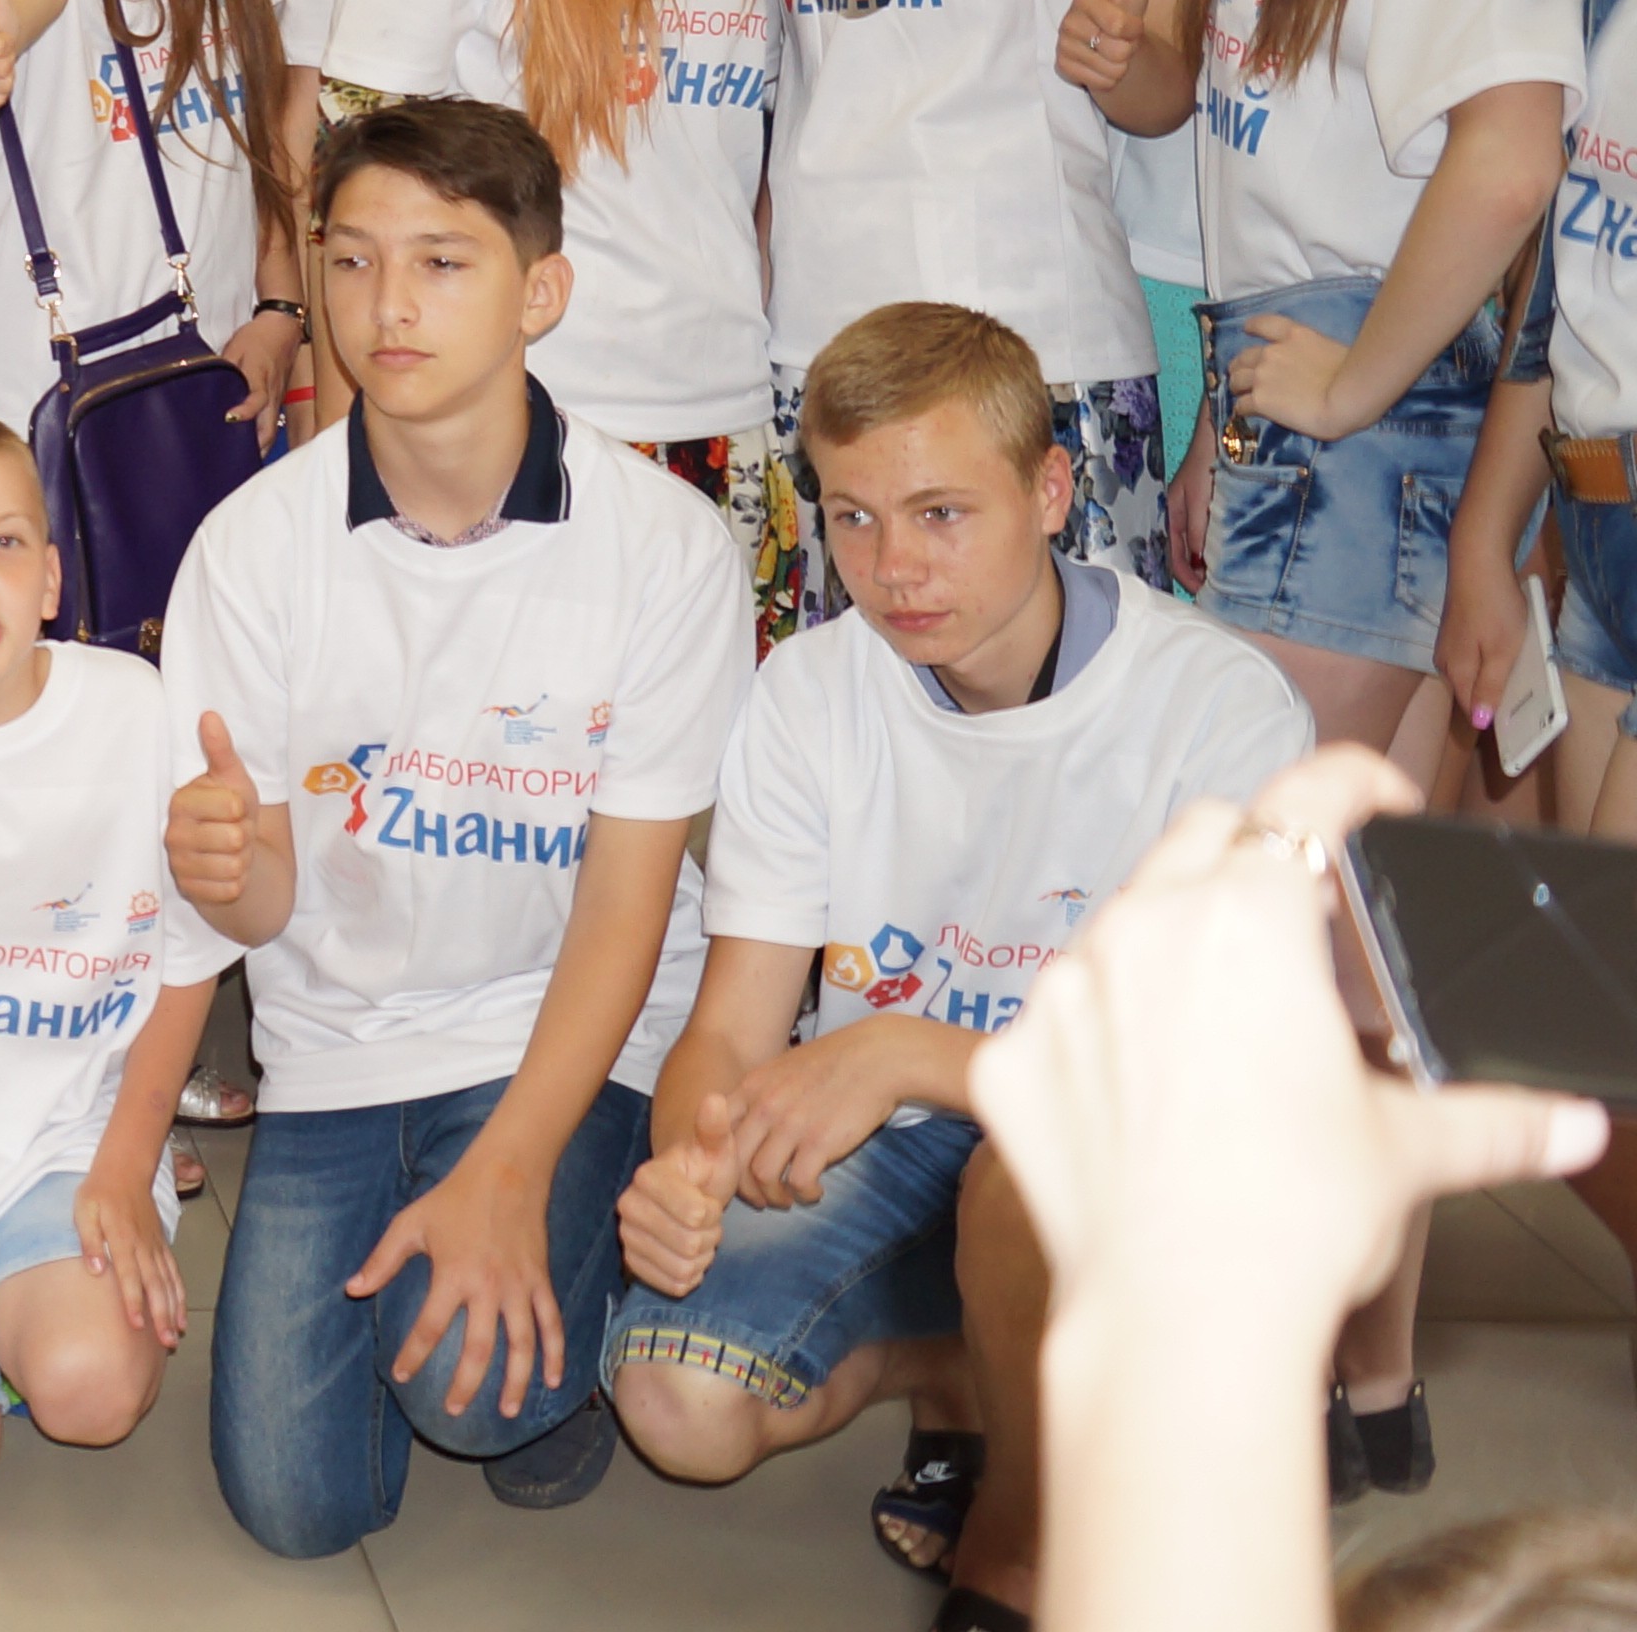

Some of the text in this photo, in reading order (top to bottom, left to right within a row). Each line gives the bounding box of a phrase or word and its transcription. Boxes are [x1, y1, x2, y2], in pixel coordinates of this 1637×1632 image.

[659, 9, 768, 41] ЛАБОРАТО
[660, 47, 766, 112] Zнани
[383, 748, 597, 797] ЛАБОРАТОРИ
[377, 786, 587, 870] Zнани
